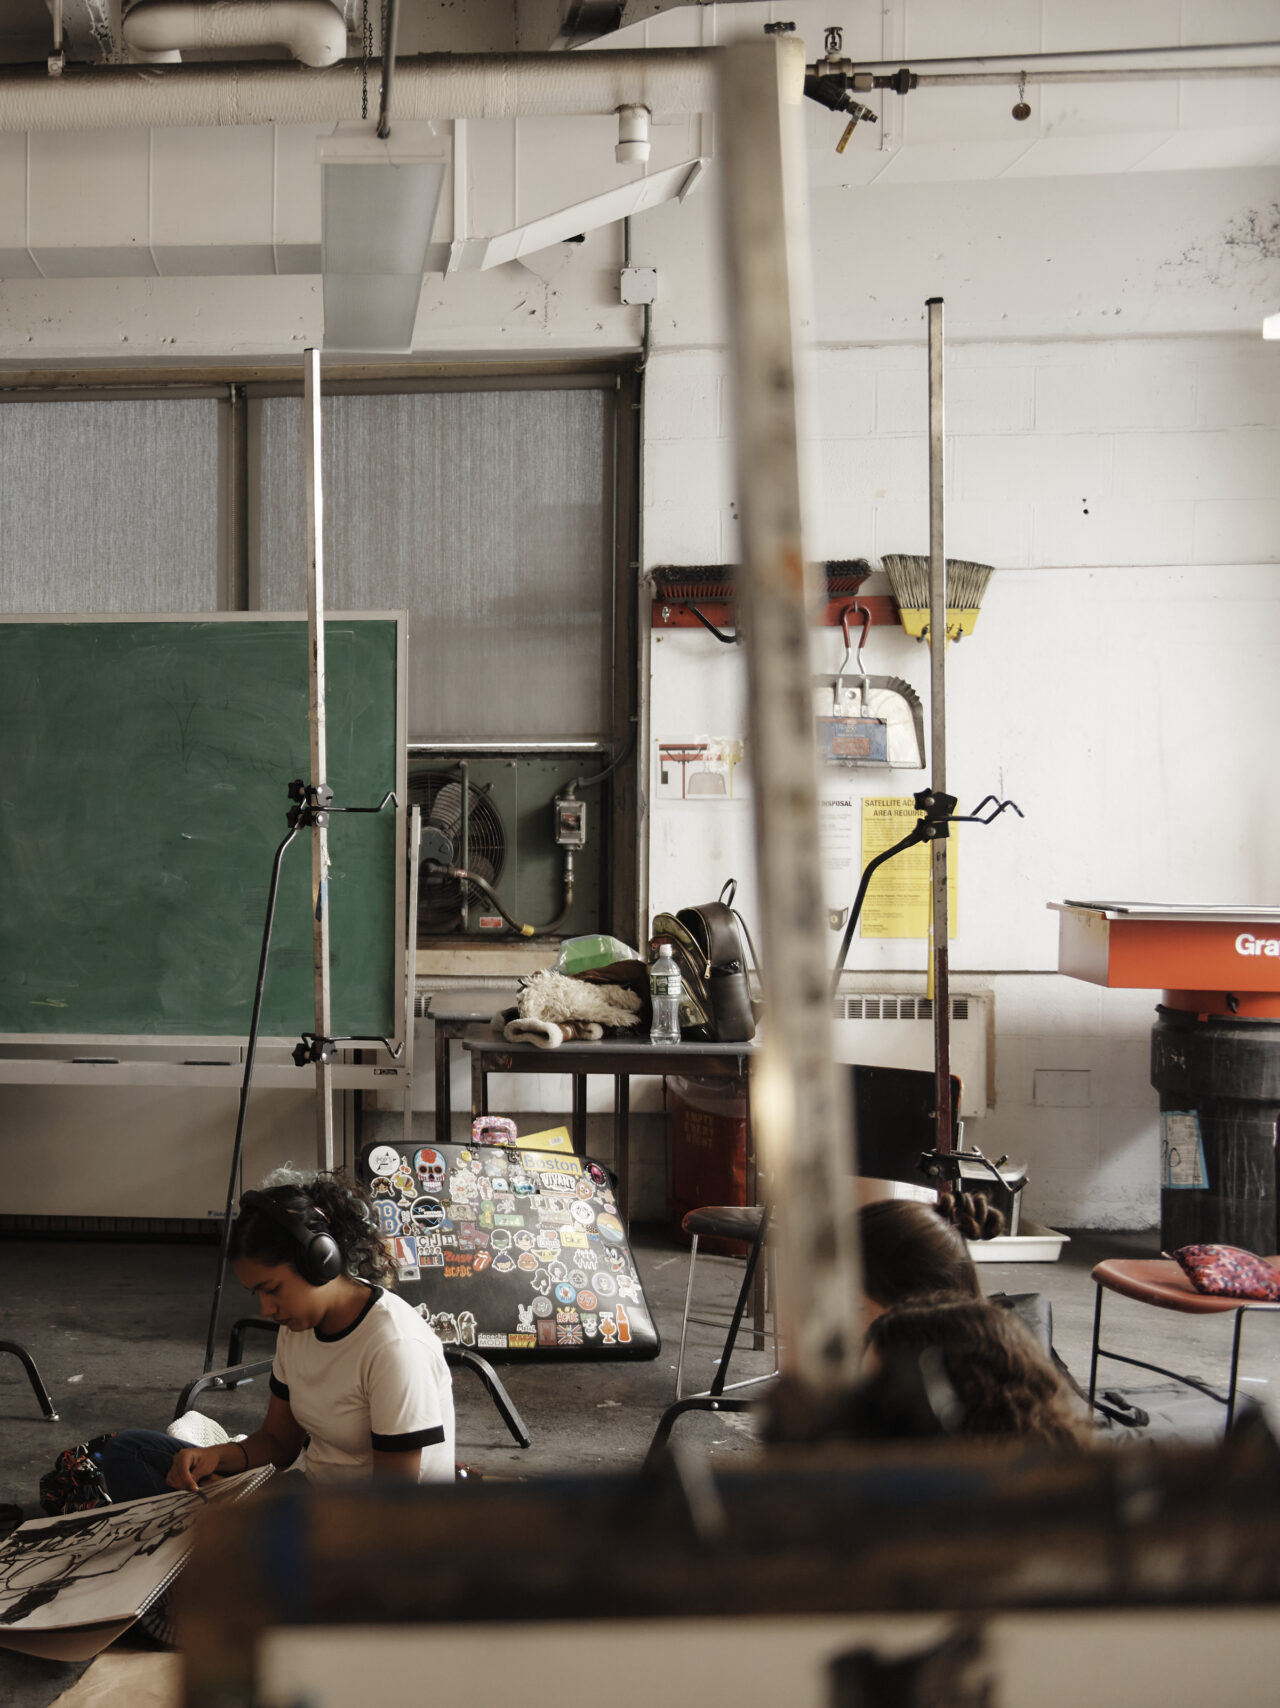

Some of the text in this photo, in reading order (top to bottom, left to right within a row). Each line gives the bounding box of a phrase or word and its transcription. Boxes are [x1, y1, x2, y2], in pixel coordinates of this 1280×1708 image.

[873, 809, 927, 817] AREA REQUIRE
[524, 1155, 578, 1173] Boston
[479, 1339, 506, 1347] MODE
